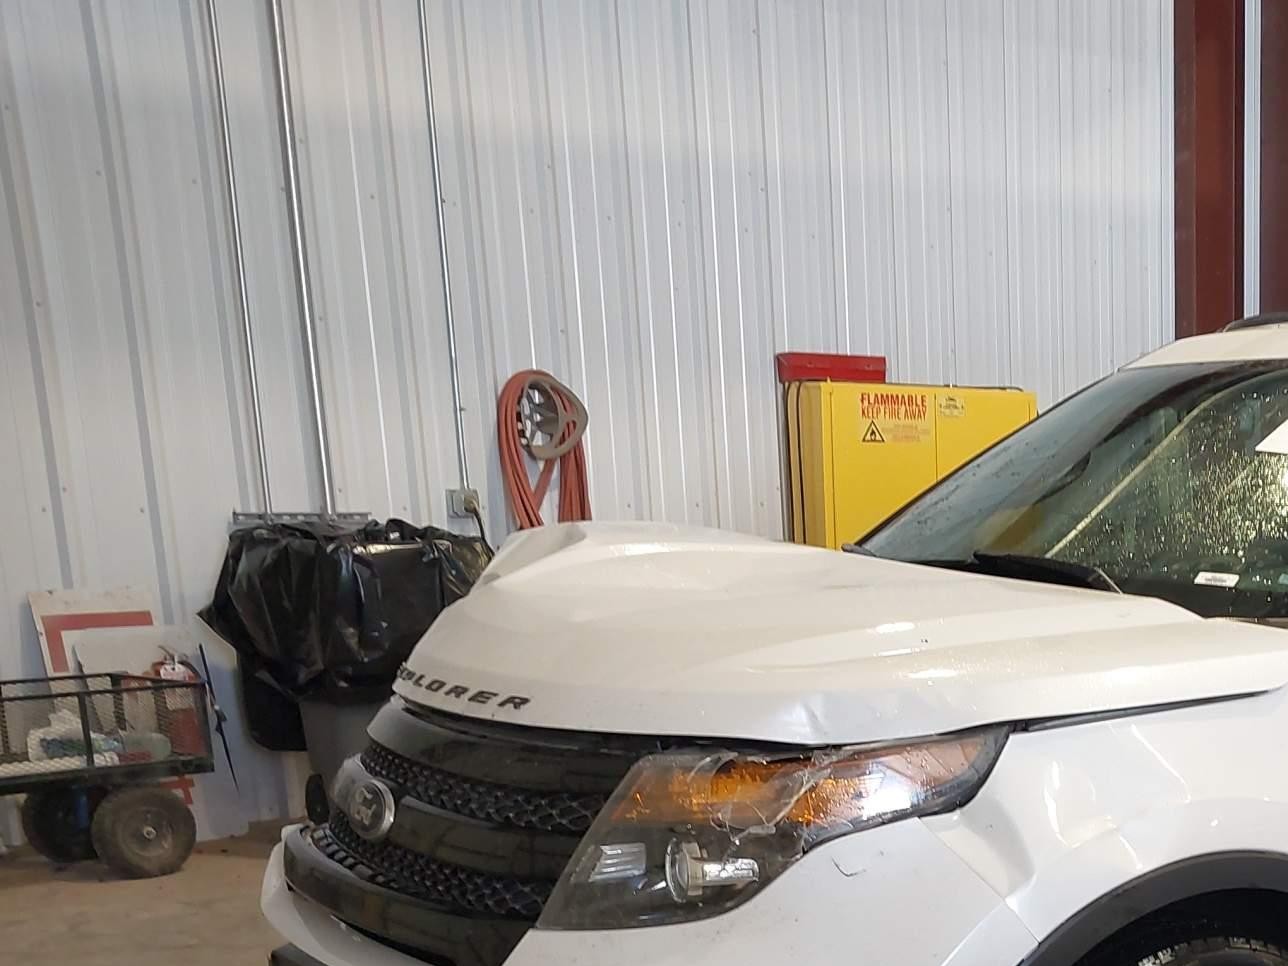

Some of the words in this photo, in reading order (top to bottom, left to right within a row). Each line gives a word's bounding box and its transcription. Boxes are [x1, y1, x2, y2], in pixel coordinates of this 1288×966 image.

[860, 392, 928, 407] FLAMMABLE
[861, 405, 881, 419] KEEP
[884, 406, 902, 420] FIRE
[904, 407, 928, 422] AWAY
